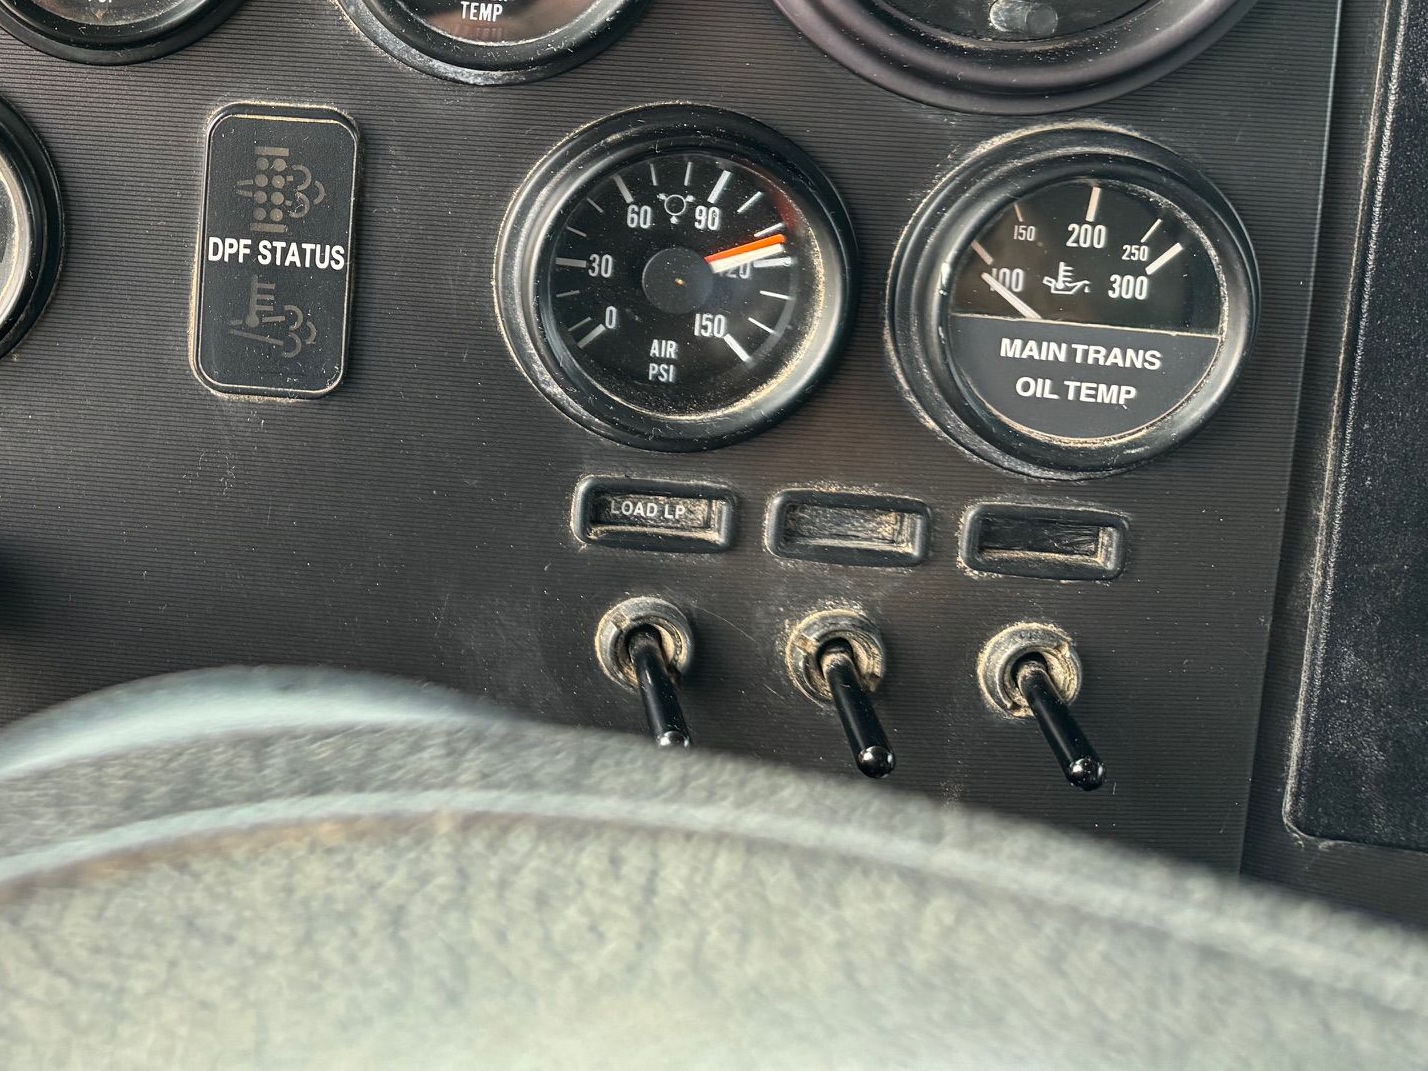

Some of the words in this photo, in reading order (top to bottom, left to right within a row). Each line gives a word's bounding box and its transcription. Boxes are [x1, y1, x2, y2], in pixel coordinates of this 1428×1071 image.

[461, 1, 504, 22] TEMP
[627, 205, 652, 229] 60
[694, 205, 720, 230] 90
[1013, 225, 1036, 241] 150
[1066, 224, 1107, 249] 200
[208, 236, 252, 264] DPF
[257, 240, 346, 270] STATUS
[1121, 244, 1149, 262] 250
[587, 253, 613, 278] 30
[1108, 274, 1149, 300] 300
[605, 305, 616, 329] 0
[694, 313, 726, 338] 150
[649, 340, 677, 359] AIR
[999, 337, 1068, 363] MAIN
[1072, 344, 1163, 370] TRANS
[648, 363, 676, 382] PSI
[1015, 376, 1060, 400] OIL
[1064, 380, 1137, 405] TEMP
[611, 500, 658, 517] LOAD
[664, 503, 686, 520] LP
